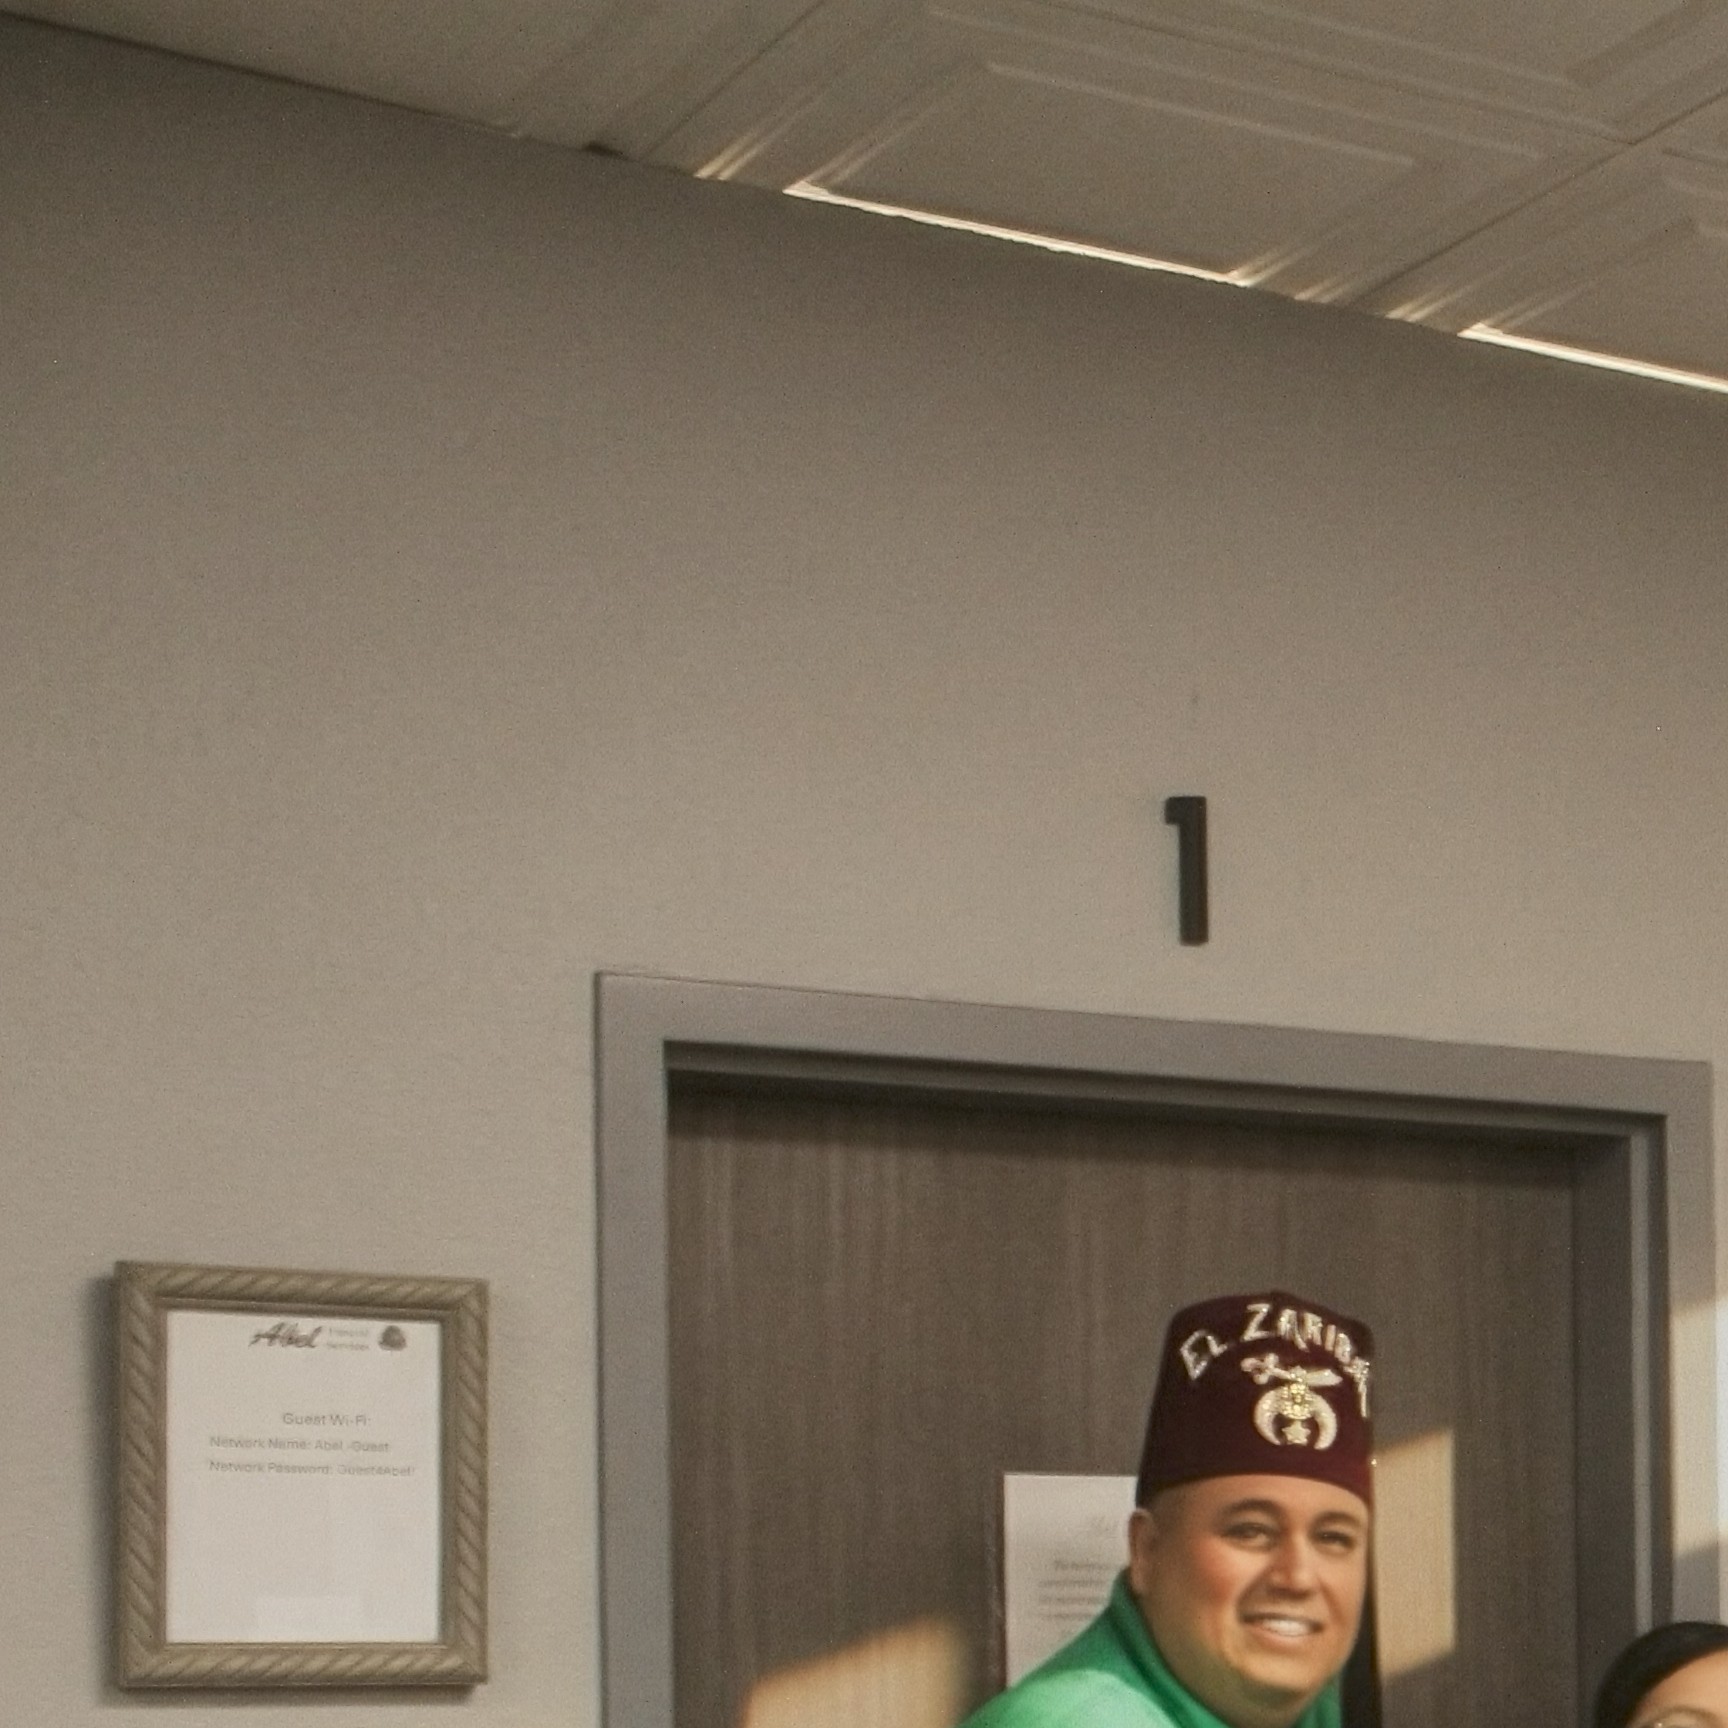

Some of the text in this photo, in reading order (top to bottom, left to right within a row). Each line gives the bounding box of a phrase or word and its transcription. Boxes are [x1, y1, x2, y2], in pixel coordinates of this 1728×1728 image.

[1164, 796, 1208, 946] 1
[282, 1412, 326, 1426] Guest
[208, 1436, 264, 1450] Network
[208, 1460, 264, 1475] Network
